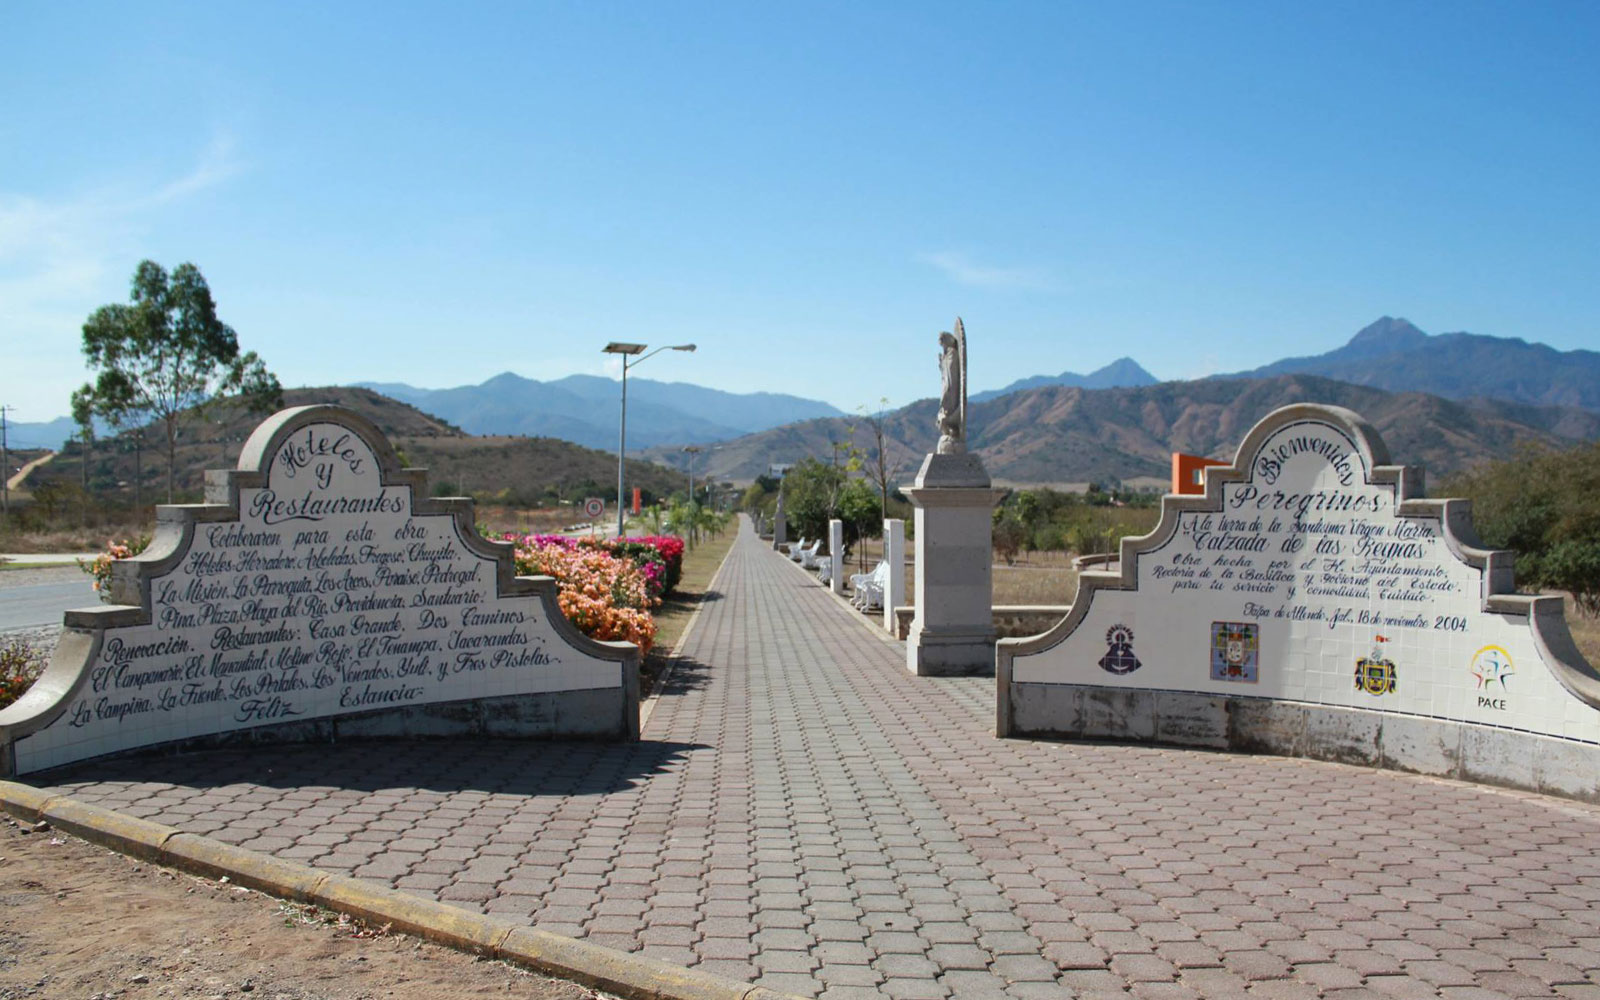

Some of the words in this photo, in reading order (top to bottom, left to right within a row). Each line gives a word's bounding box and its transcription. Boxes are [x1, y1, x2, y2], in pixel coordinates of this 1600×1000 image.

[280, 430, 364, 478] Hoteles
[1257, 435, 1353, 486] Bienvenidos
[249, 489, 404, 525] Restaurantes
[206, 524, 281, 548] Colaboraron
[293, 530, 329, 550] para
[346, 521, 373, 541] esta
[394, 518, 427, 540] obra
[1183, 515, 1198, 532] A
[1200, 515, 1212, 531] la
[1218, 515, 1246, 532] tierra
[1248, 516, 1263, 532] de
[1267, 516, 1282, 532] la
[1280, 534, 1303, 553] de
[1316, 534, 1342, 554] las
[1173, 553, 1202, 566] Obra
[1213, 554, 1252, 567] hecha
[1267, 560, 1291, 574] por
[1300, 558, 1316, 570] el
[1199, 567, 1212, 578] de
[1221, 568, 1233, 579] la
[1303, 574, 1313, 588] y
[1377, 576, 1398, 588] del
[155, 580, 177, 605] La
[232, 575, 248, 599] La
[315, 570, 334, 593] Los
[1171, 580, 1200, 593] para
[1210, 580, 1224, 591] tu
[1232, 582, 1276, 593] servicio
[1287, 586, 1296, 600] y
[240, 599, 278, 626] Playa
[281, 596, 299, 617] del
[309, 619, 346, 640] Casa
[417, 609, 448, 629] Dos
[1243, 602, 1270, 619] Talpa
[1274, 605, 1285, 617] de
[1357, 609, 1369, 624] 18
[1370, 611, 1381, 624] de
[1384, 614, 1429, 628] noviembre
[92, 665, 114, 693] El
[185, 654, 204, 679] El
[270, 646, 313, 670] Molino
[358, 636, 376, 659] El
[69, 700, 92, 727] La
[157, 687, 177, 711] La
[229, 677, 251, 699] Los
[311, 667, 335, 689] Los
[437, 661, 448, 681] y
[453, 651, 487, 673] Tres
[1477, 696, 1506, 710] PACE
[234, 696, 307, 722] Feliz
